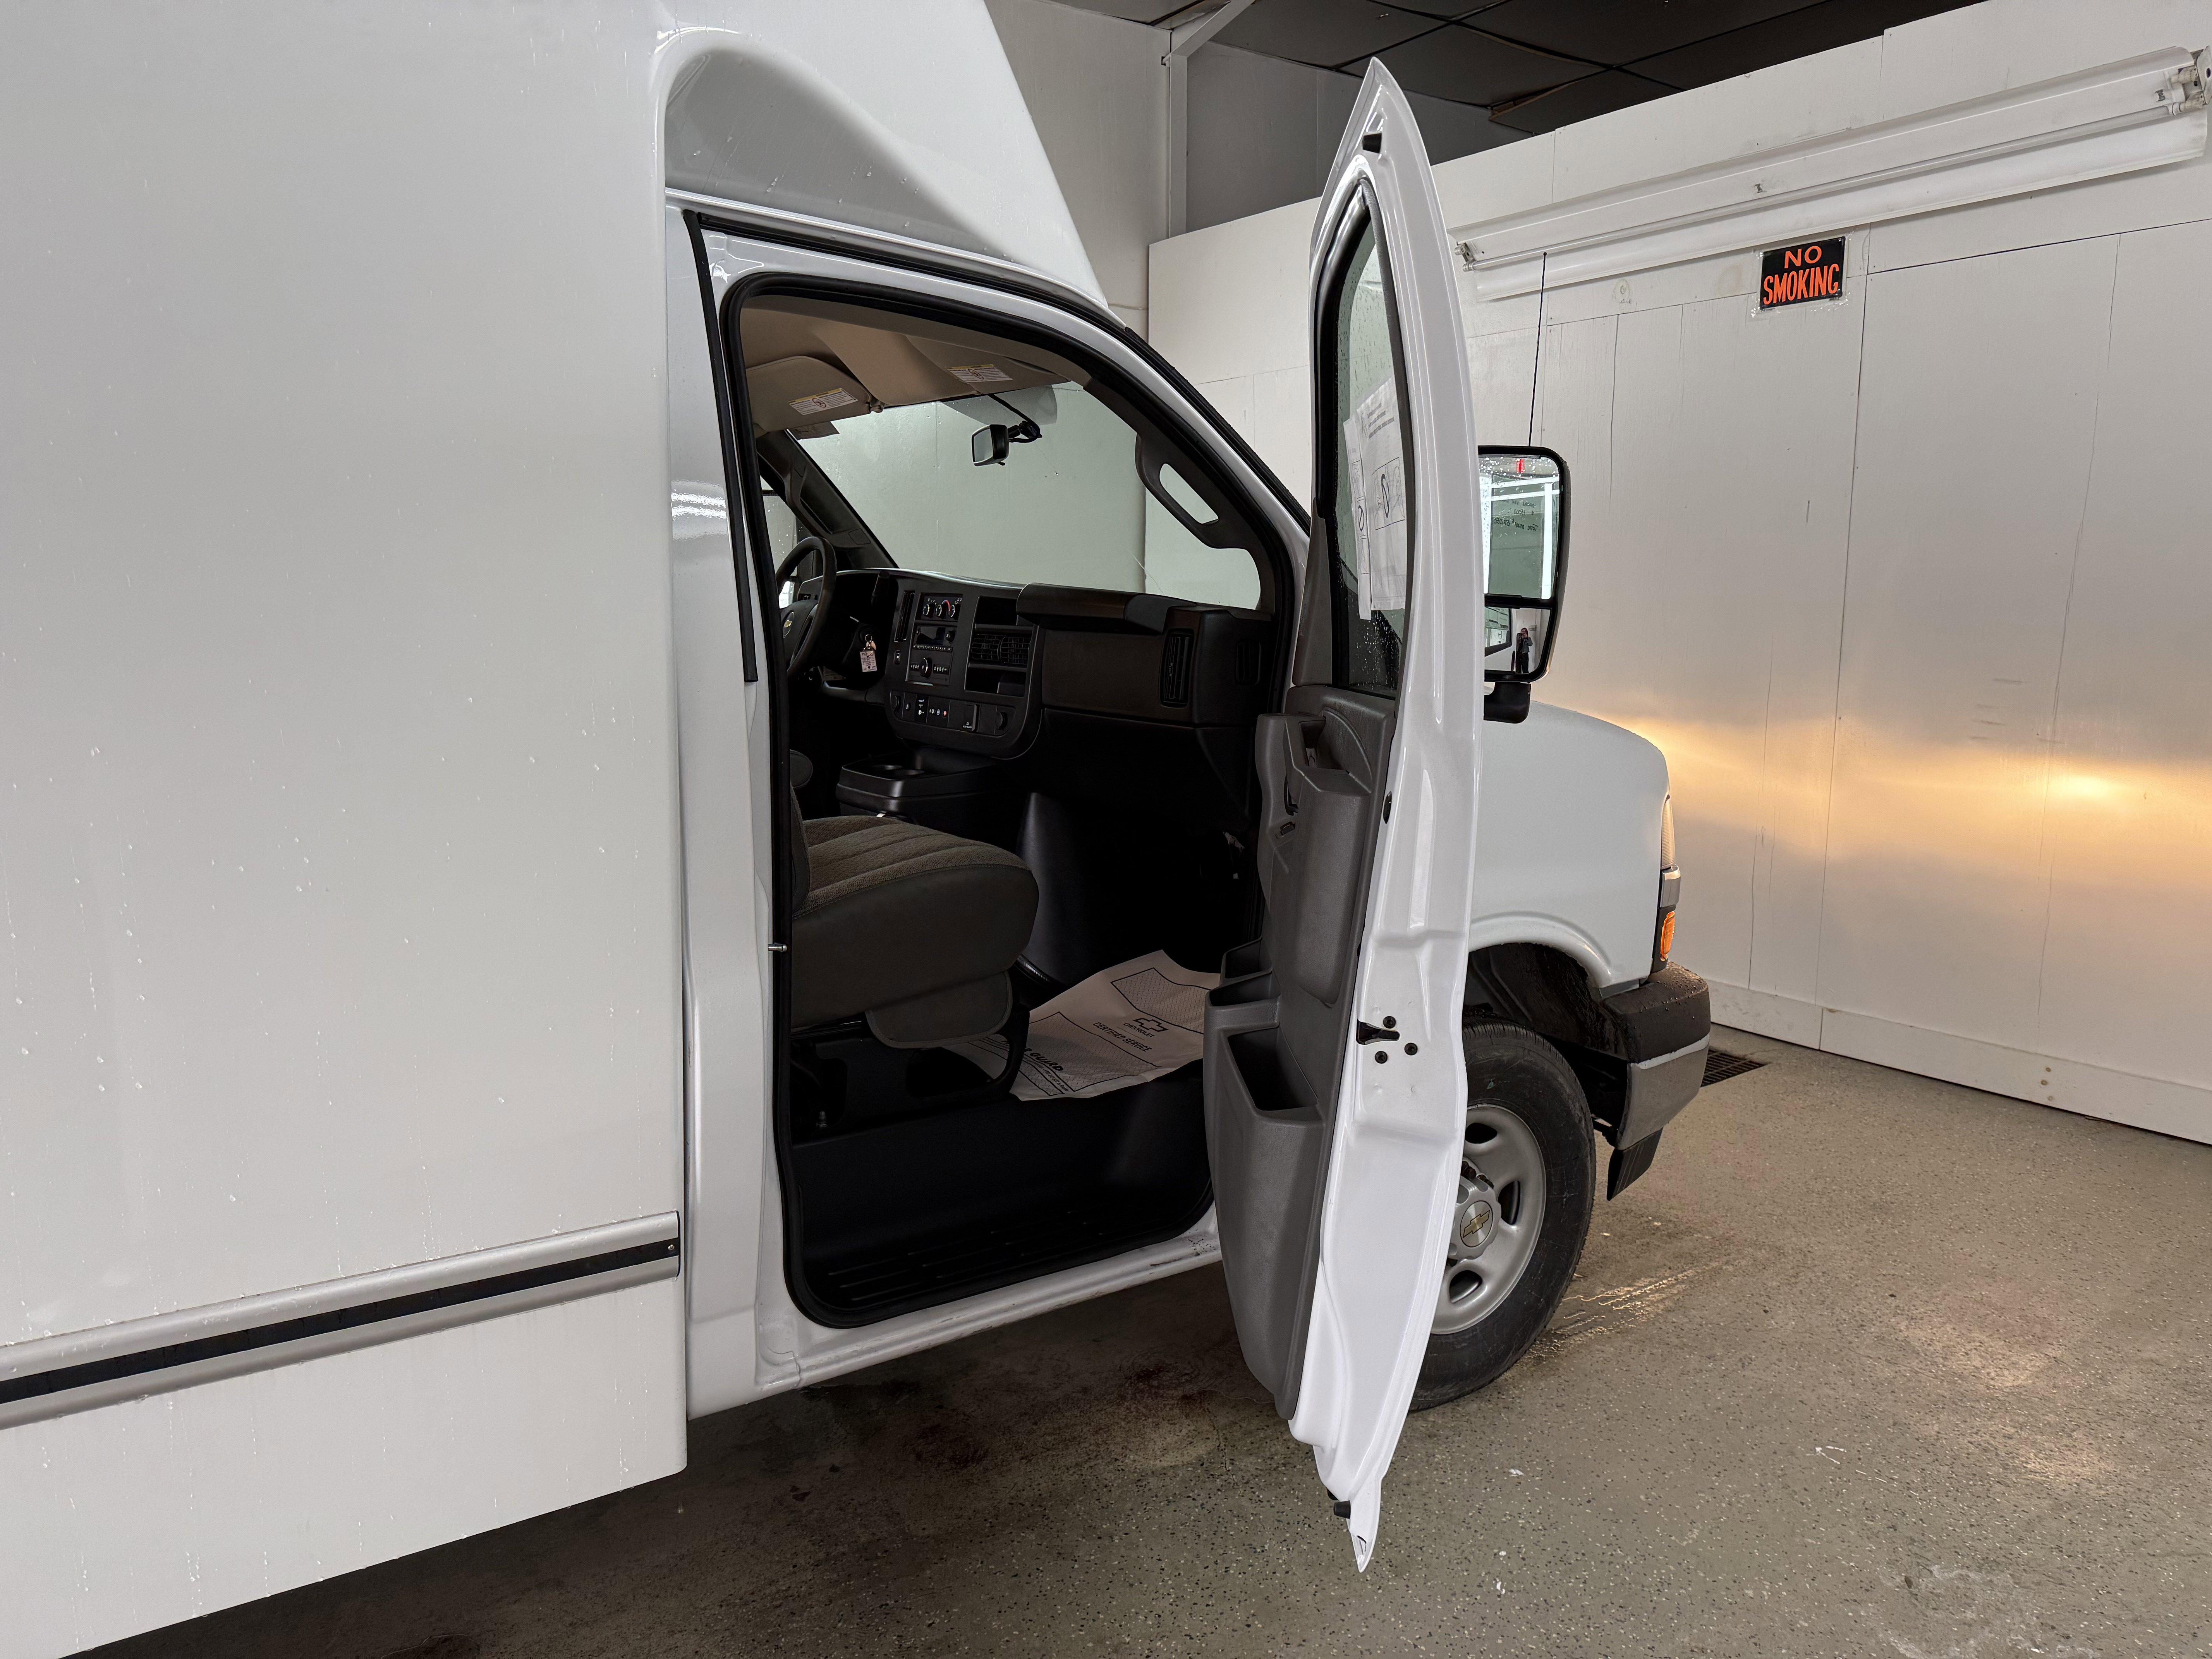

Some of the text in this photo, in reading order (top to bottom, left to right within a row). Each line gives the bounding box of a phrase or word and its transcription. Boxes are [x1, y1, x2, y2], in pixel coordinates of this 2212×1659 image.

[1784, 246, 1822, 269] NO
[1763, 263, 1839, 305] SMOKING
[1093, 1022, 1152, 1052] CERTIFIED SERVICE
[1123, 1022, 1155, 1038] CHEVROLET
[1030, 1053, 1064, 1071] GUARD
